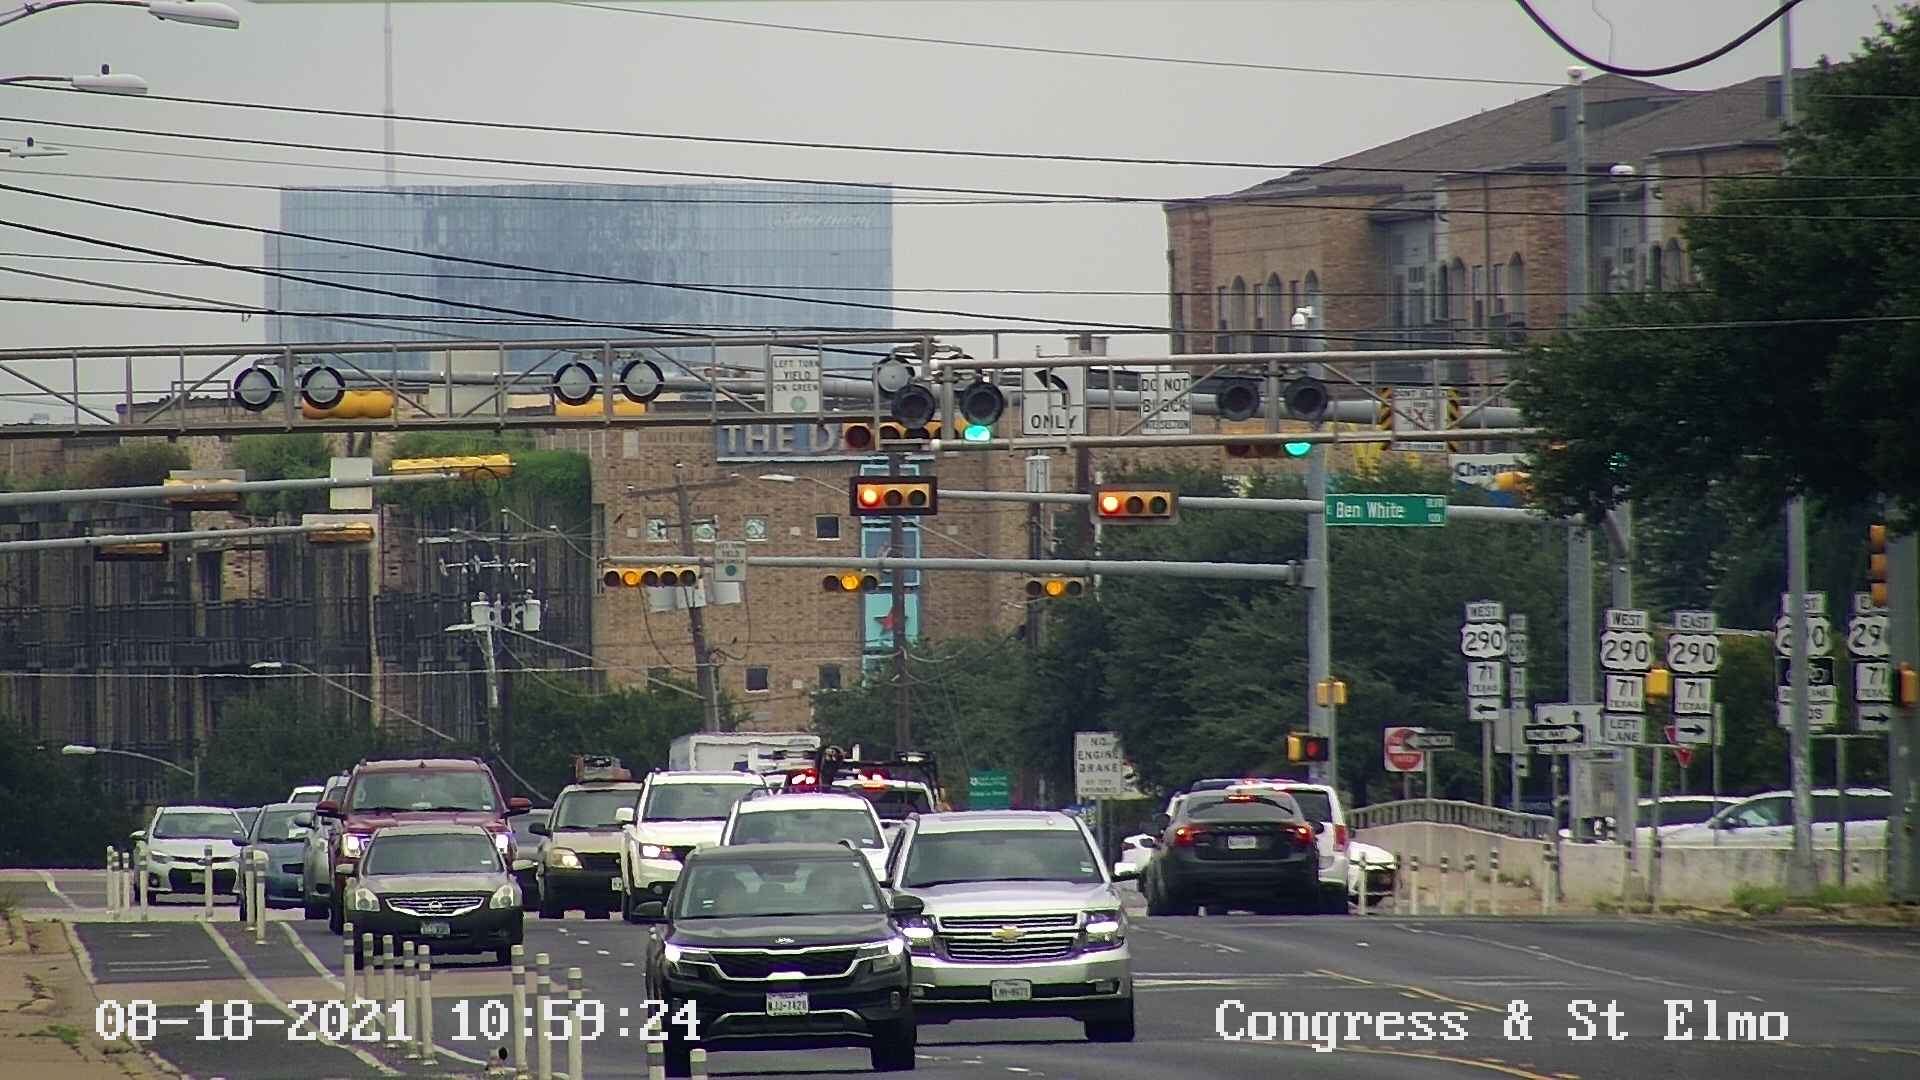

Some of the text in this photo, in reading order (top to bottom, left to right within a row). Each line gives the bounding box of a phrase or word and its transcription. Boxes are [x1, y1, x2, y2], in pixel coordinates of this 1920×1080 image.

[784, 371, 810, 380] YIELD
[1164, 378, 1188, 391] NOT
[1031, 415, 1077, 429] ONLY
[720, 424, 793, 450] THE
[1336, 502, 1361, 519] Ben
[1366, 501, 1406, 519] White
[1470, 606, 1498, 617] WEST
[1614, 613, 1641, 625] WEST
[1680, 615, 1709, 627] EAST
[1464, 630, 1503, 651] 290
[1852, 623, 1881, 647] 29
[1604, 639, 1649, 662] 290
[1673, 642, 1716, 665] 290
[1477, 665, 1493, 680] 71
[1866, 666, 1886, 684] 71
[1615, 679, 1635, 697] 71
[1684, 681, 1704, 698] 71
[1610, 720, 1637, 729] LEFT
[1091, 737, 1106, 746] NO
[1608, 732, 1640, 742] LANE
[1078, 750, 1119, 760] ENGINE
[1080, 763, 1119, 773] BRAKE
